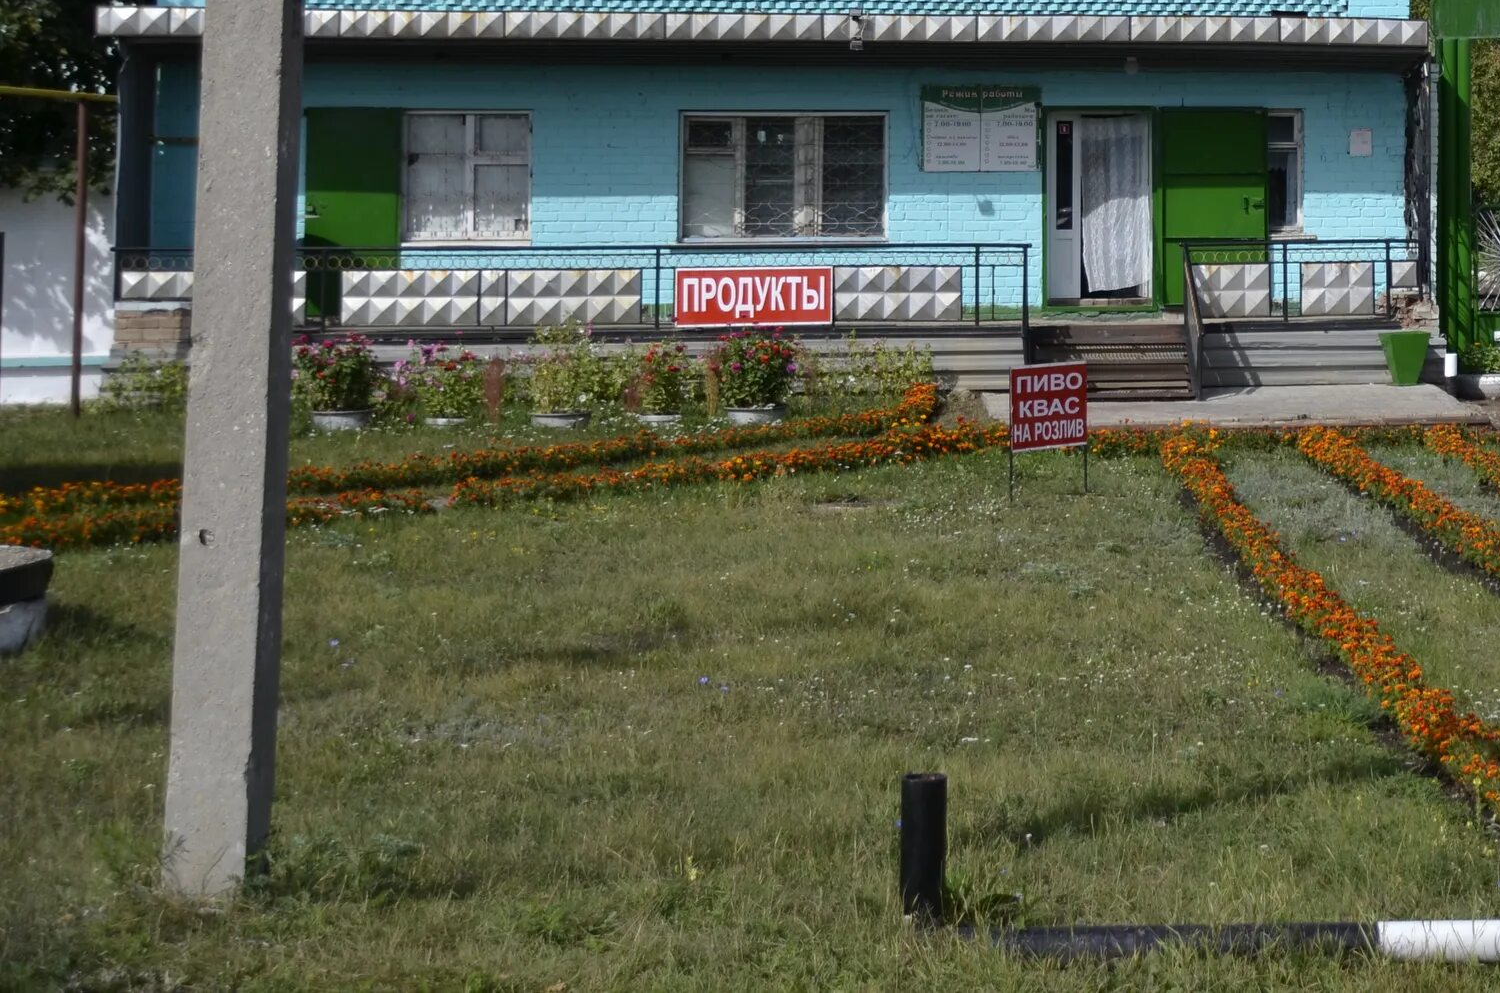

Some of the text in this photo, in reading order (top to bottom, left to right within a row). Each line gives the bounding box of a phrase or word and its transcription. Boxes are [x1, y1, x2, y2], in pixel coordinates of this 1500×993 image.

[982, 89, 1023, 99] работы
[682, 275, 826, 318] ПРОДУКТЫ
[1016, 372, 1083, 394] ПИВО
[1019, 396, 1080, 418] КВАС
[1013, 418, 1084, 443] НА РОЗЛИВ
